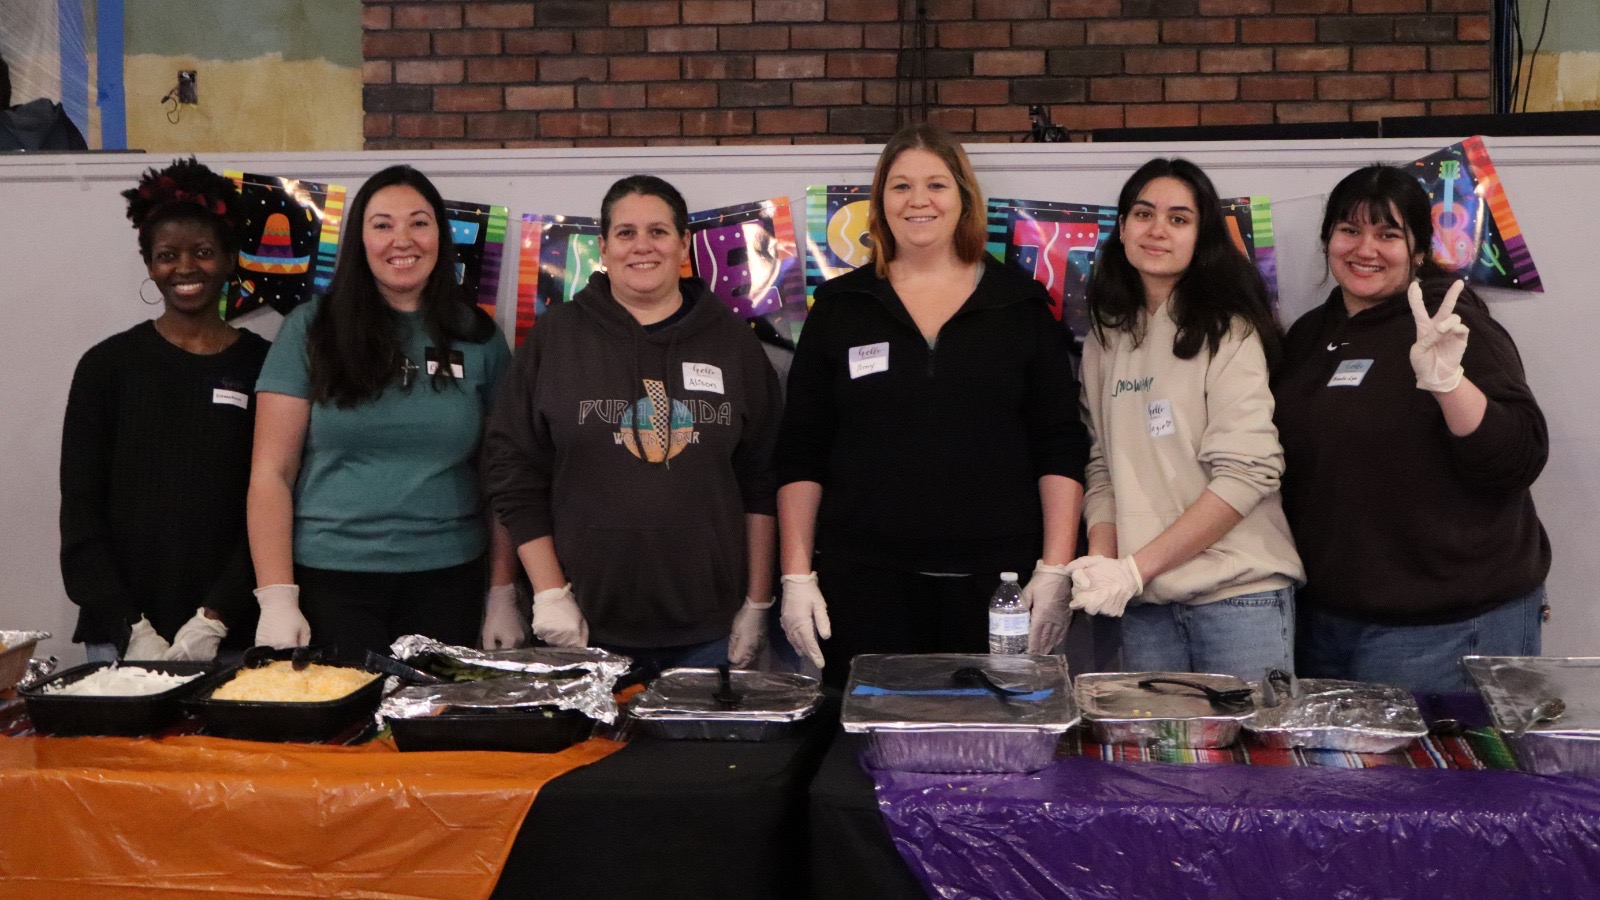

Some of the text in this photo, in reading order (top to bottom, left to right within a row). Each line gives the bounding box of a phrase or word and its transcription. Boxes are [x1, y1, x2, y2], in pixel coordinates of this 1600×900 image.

[857, 363, 876, 373] Amy
[689, 378, 717, 389] Alison
[578, 399, 732, 426] PURA VIDA
[1149, 421, 1165, 436] ngie
[671, 431, 700, 445] TOUR
